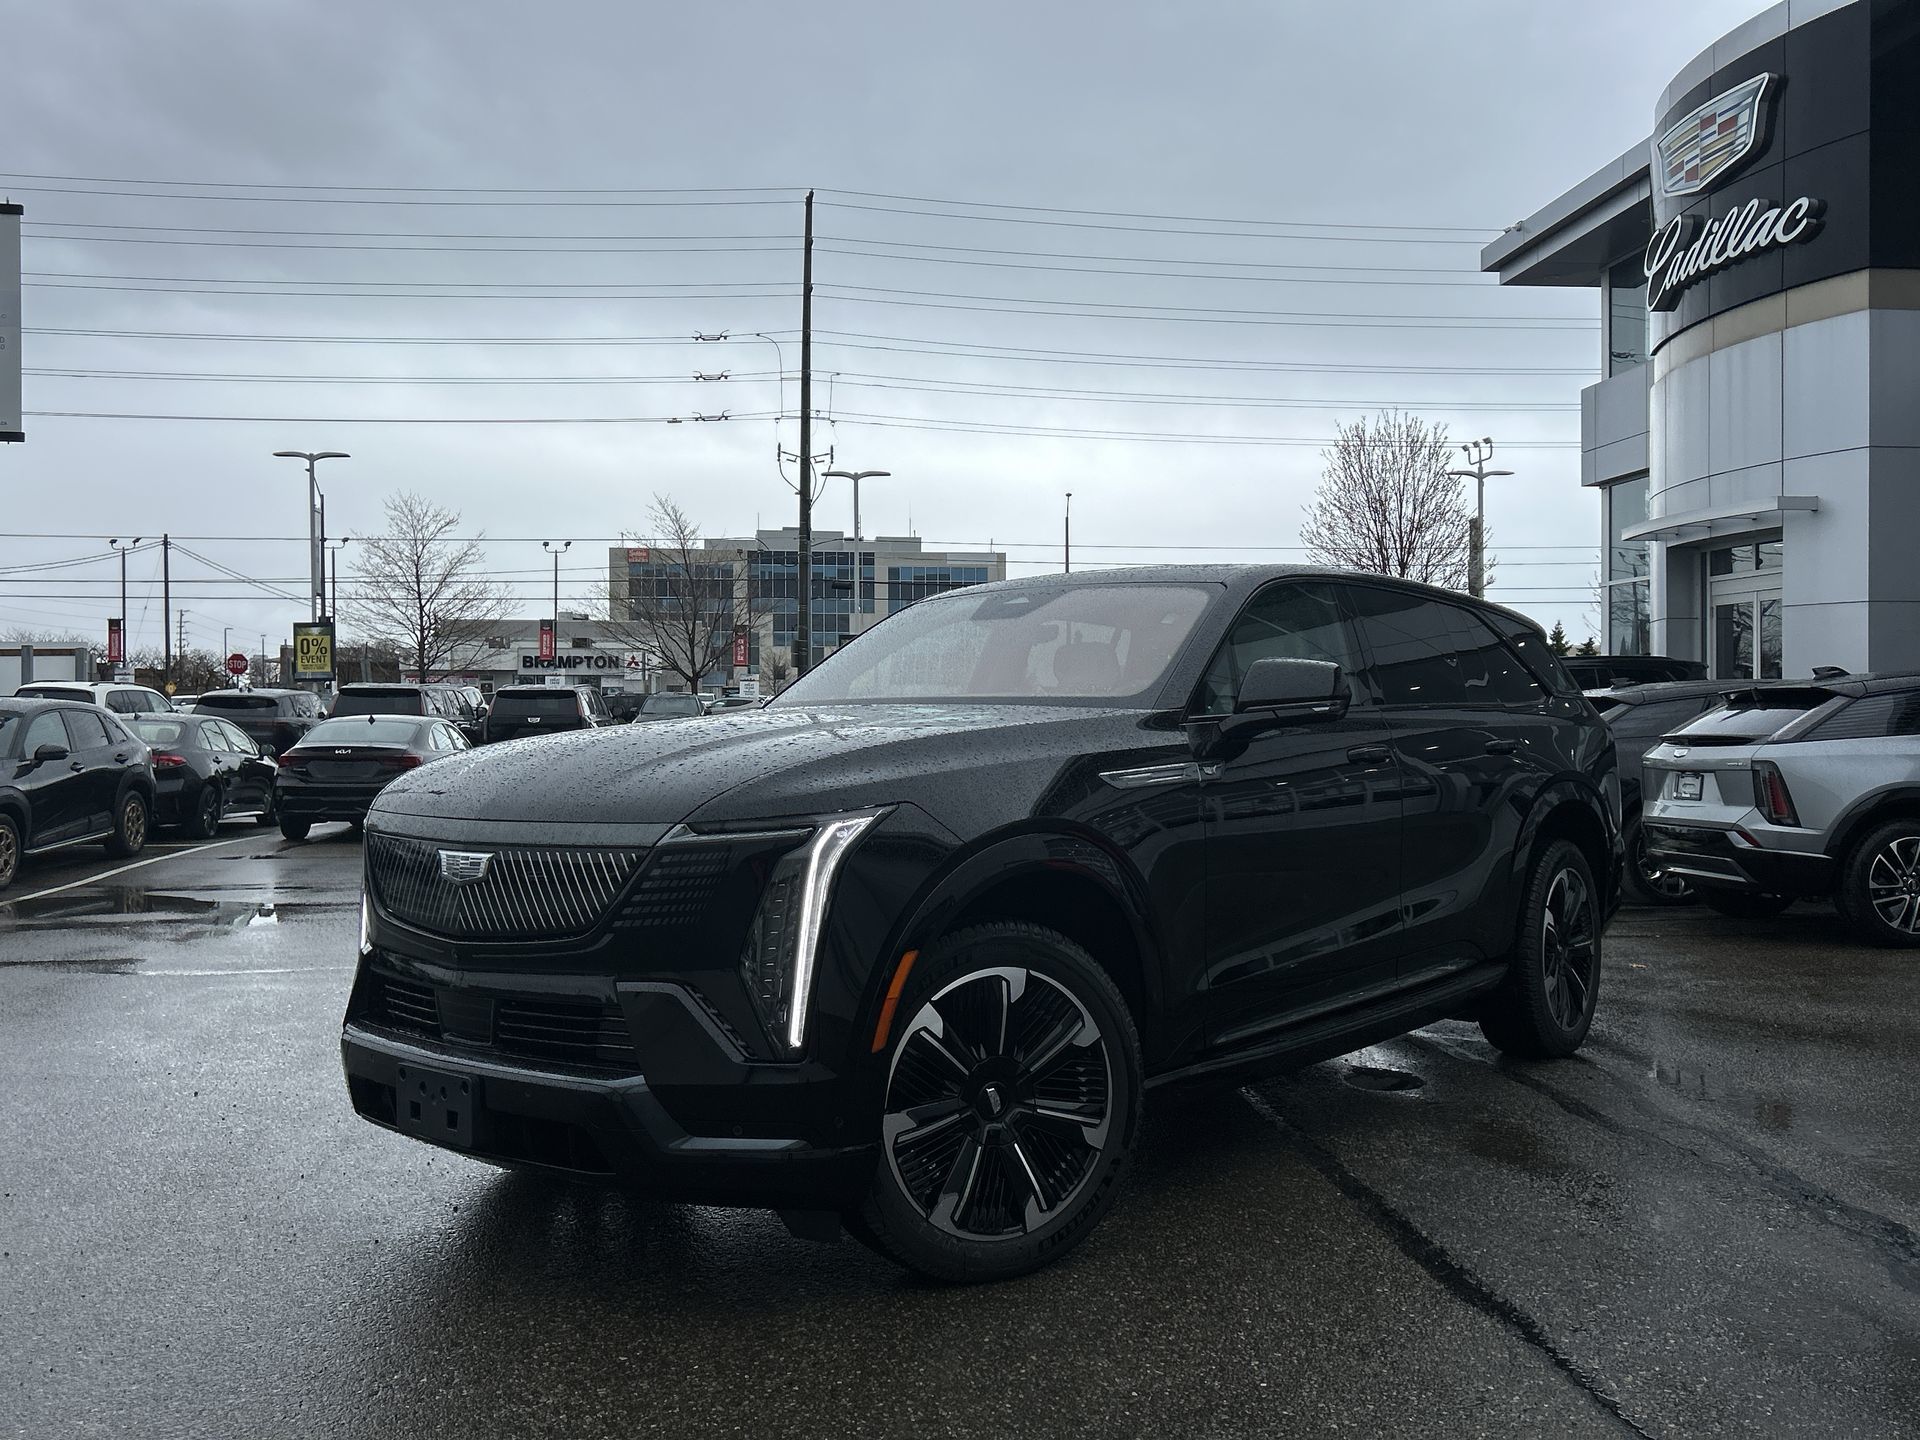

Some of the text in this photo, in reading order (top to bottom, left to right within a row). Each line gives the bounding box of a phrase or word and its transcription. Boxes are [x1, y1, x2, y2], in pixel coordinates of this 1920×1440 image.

[1644, 197, 1810, 312] Cadillac
[300, 638, 328, 655] 0%
[228, 660, 247, 669] STOP
[300, 655, 327, 664] EVENT
[522, 655, 620, 669] BRAMPTON
